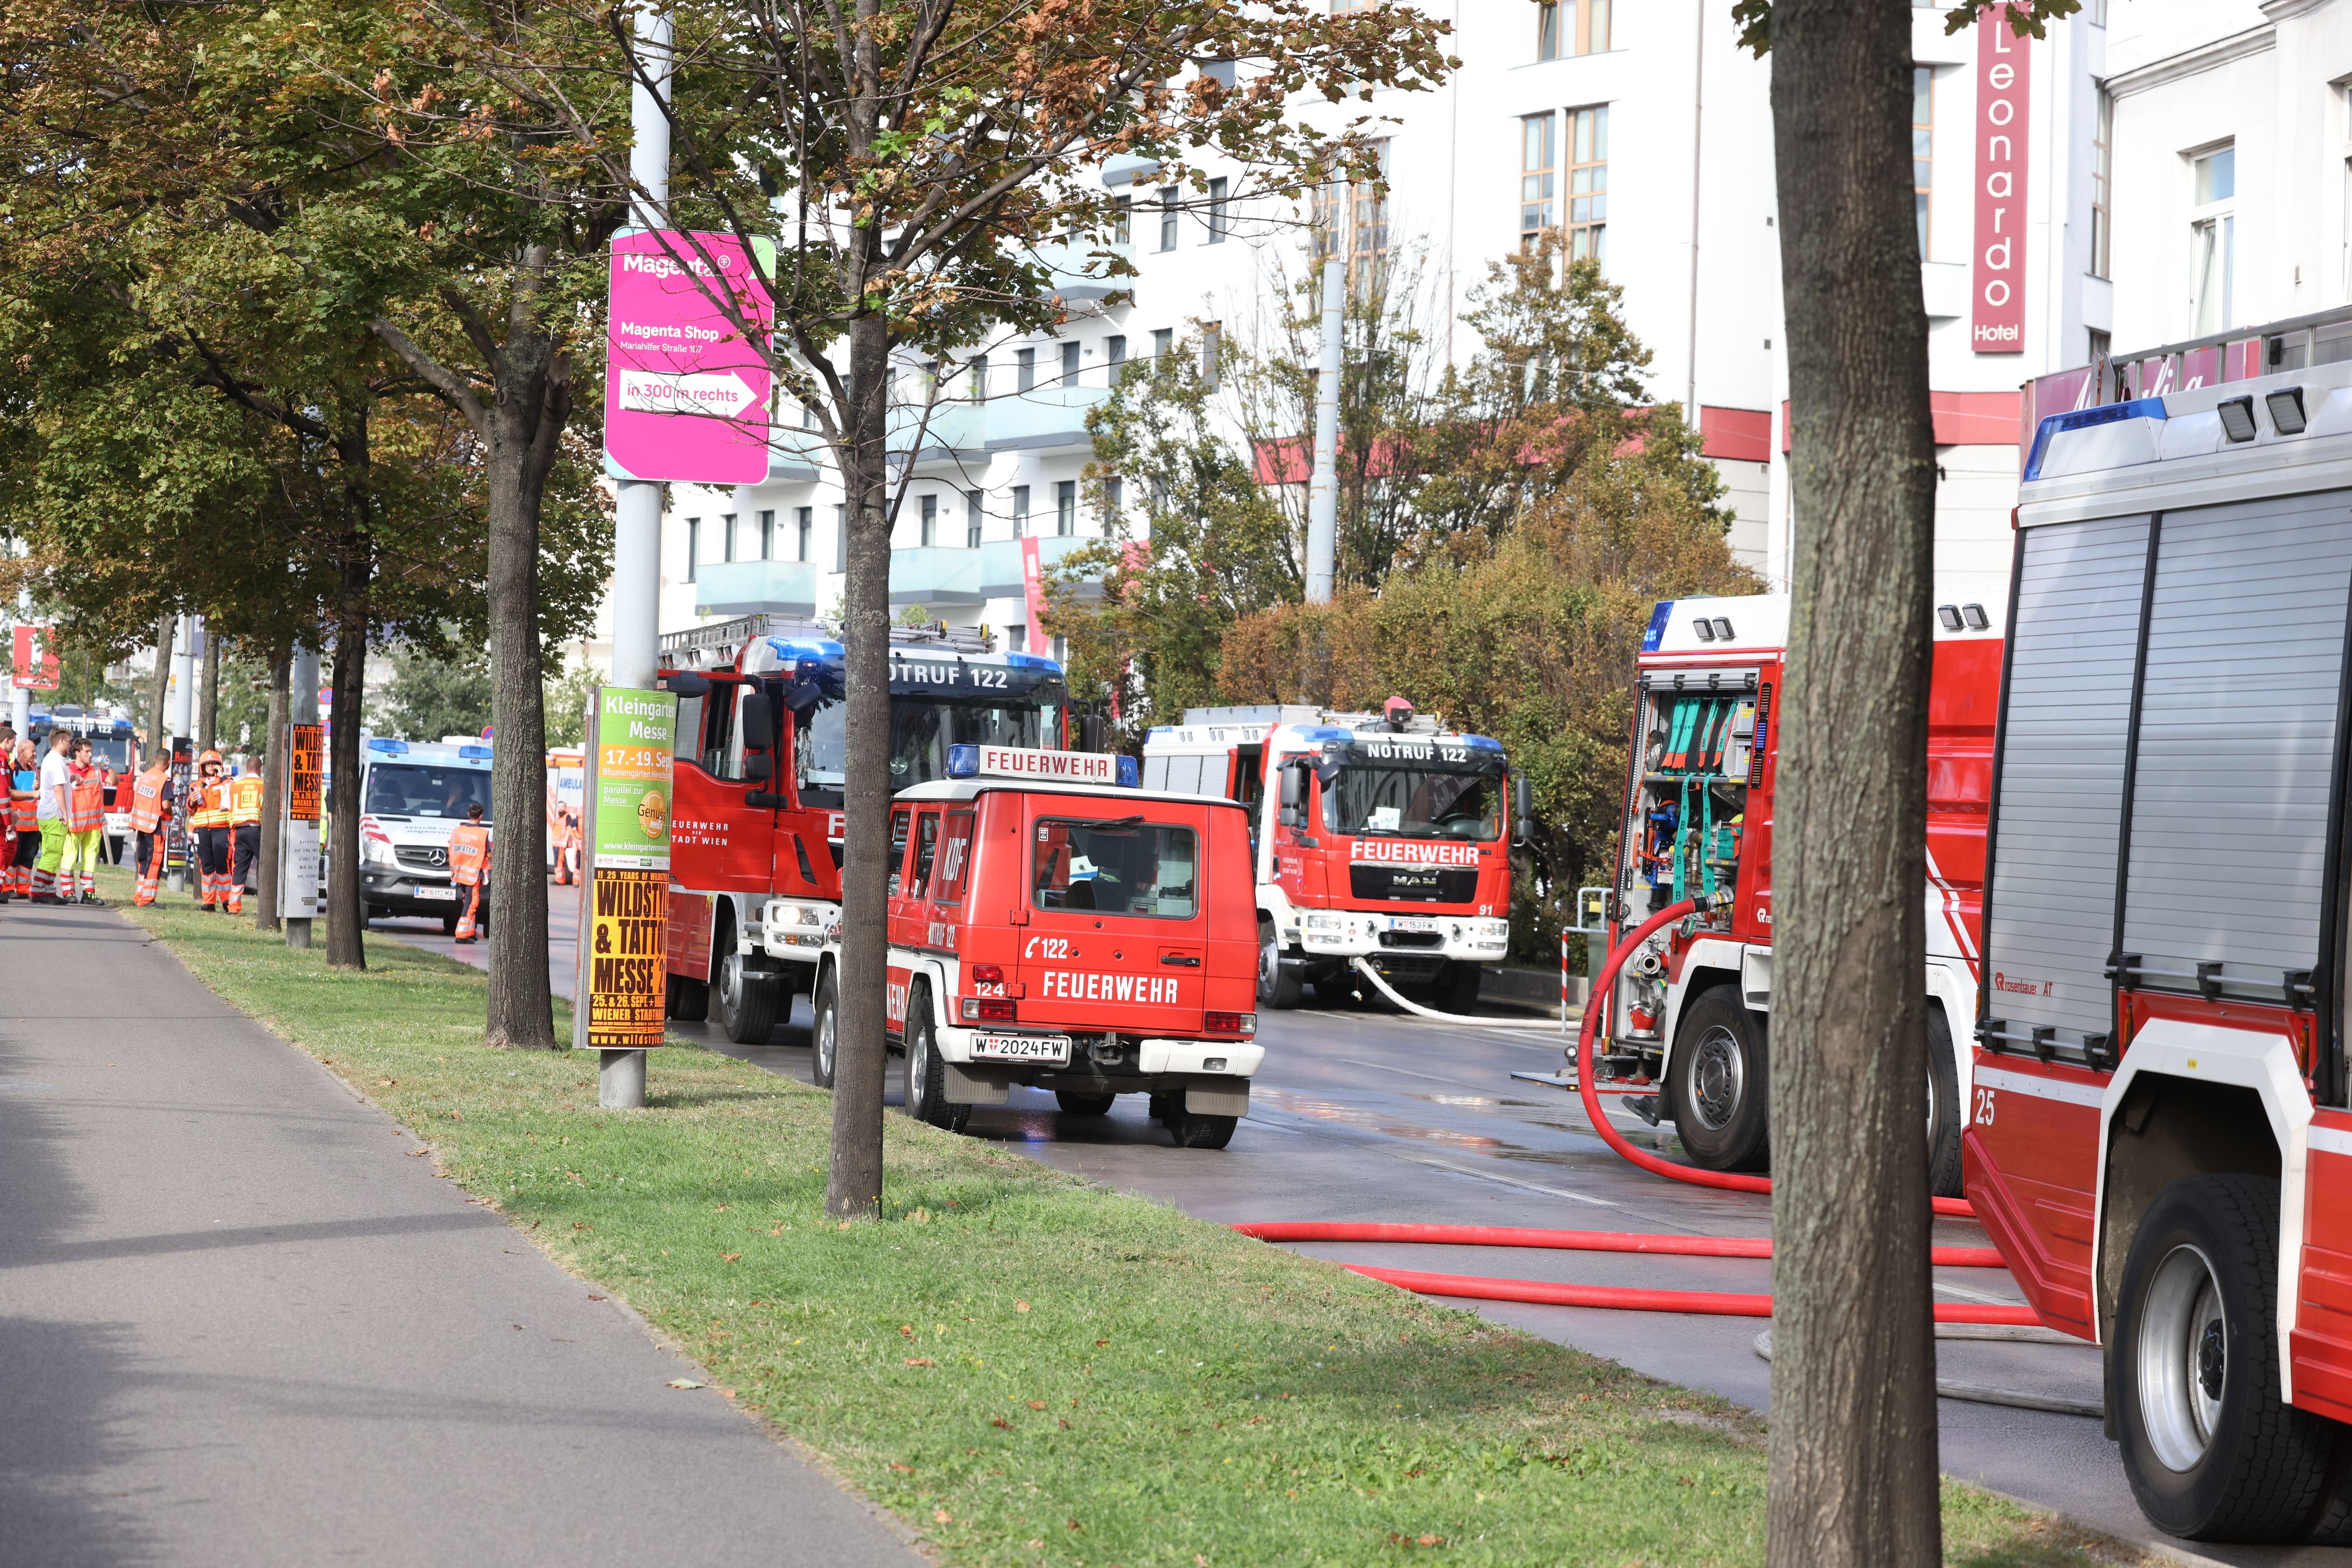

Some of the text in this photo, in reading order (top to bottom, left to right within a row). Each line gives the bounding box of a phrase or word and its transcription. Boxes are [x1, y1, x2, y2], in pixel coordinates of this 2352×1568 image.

[1985, 21, 2014, 306] Leonardo
[621, 322, 719, 343] Magenta Shop
[1975, 324, 2018, 341] Hotel
[620, 341, 660, 351] Mariahilfer
[662, 343, 687, 353] Straße
[627, 383, 739, 402] in 300 m rechts
[889, 663, 1008, 688] OTRUF 122
[605, 696, 676, 720] Kleingarten
[98, 726, 112, 734] 122
[629, 721, 667, 740] Messe
[294, 752, 323, 771] & TATT
[606, 749, 653, 767] 17.-19.
[1368, 744, 1467, 763] NOTRUF 122
[987, 751, 1107, 777] FEUERWEHR
[603, 767, 650, 779] Blumengärten
[559, 778, 583, 790] AMBULA
[603, 785, 632, 795] parallel
[242, 794, 255, 803] EL
[603, 796, 627, 804] Messe
[637, 804, 666, 821] Genuss
[672, 820, 729, 831] EUERWEHR
[671, 835, 728, 846] TADT WIEN
[942, 837, 967, 881] KDF
[1351, 841, 1479, 864] FEUERWEHR
[607, 871, 616, 880] 25
[620, 871, 639, 880] YEARS
[642, 872, 649, 880] OF
[1393, 875, 1436, 886] MAN
[597, 881, 669, 918] WILDSTYL
[1479, 904, 1493, 916] 91
[595, 924, 611, 954] &
[928, 921, 956, 948] NOTRUF 122
[1041, 938, 1068, 959] 122
[594, 958, 653, 994] MESSE
[974, 982, 1005, 997] 124
[1043, 971, 1178, 1004] FEUERWEHR
[2043, 981, 2053, 997] AT
[592, 995, 607, 1007] 25.
[609, 997, 615, 1007] &
[616, 995, 630, 1008] 26.
[630, 995, 648, 1008] SEPT.
[592, 1008, 631, 1021] WIENER
[976, 1038, 987, 1052] W
[1976, 1088, 1995, 1126] 25
